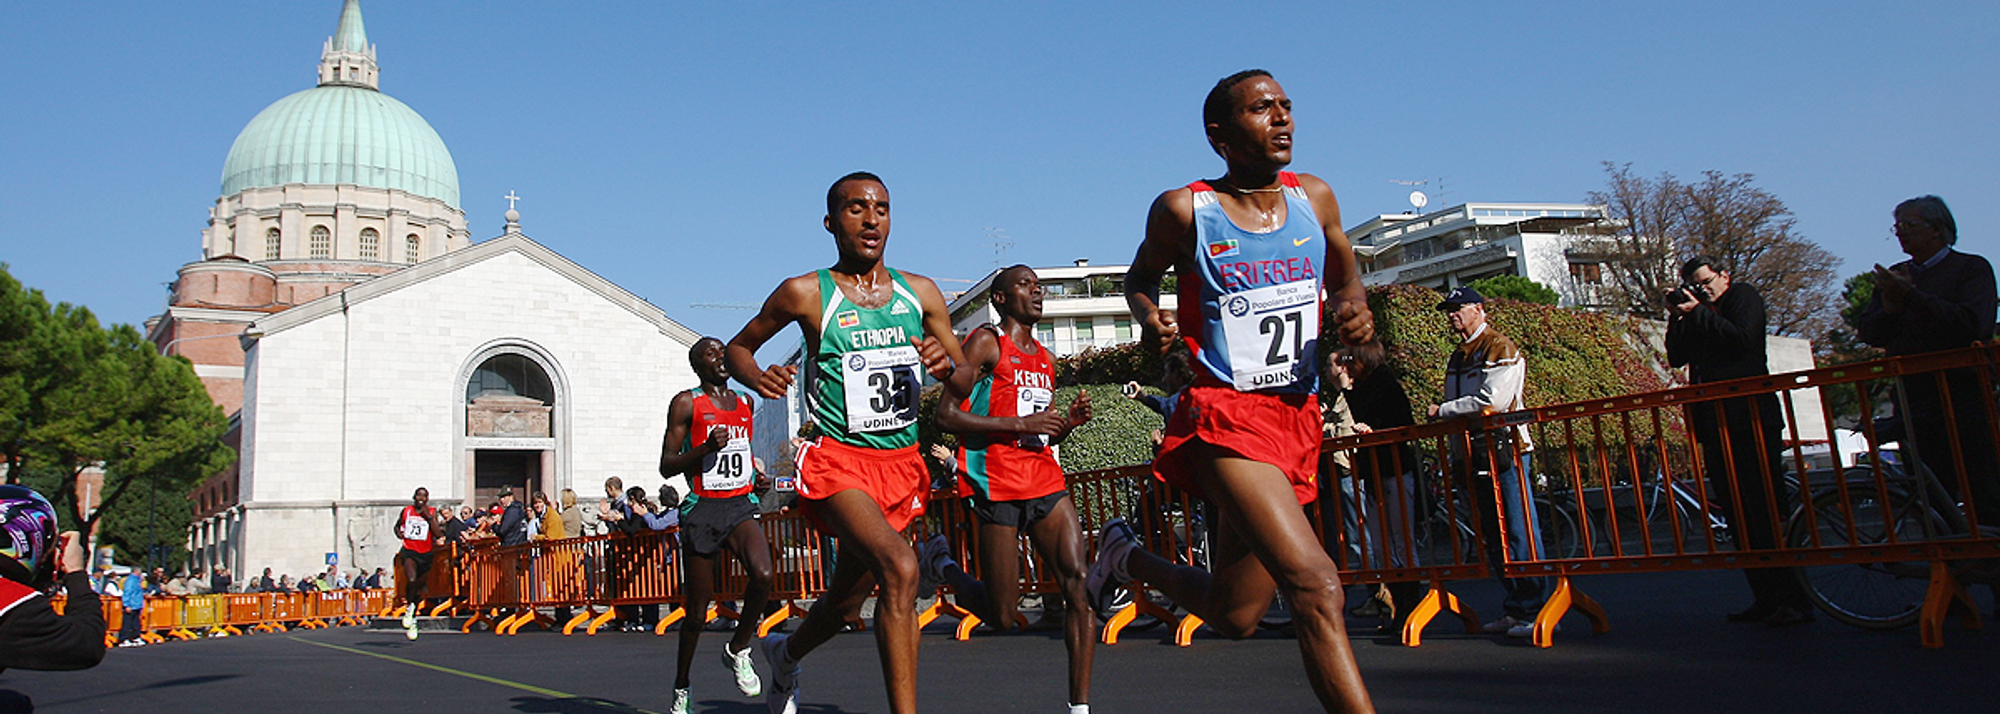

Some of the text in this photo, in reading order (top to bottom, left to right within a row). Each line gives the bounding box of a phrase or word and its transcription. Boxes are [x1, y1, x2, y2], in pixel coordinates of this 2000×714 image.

[1220, 257, 1315, 287] ERITREA
[851, 326, 906, 348] ETHIOPIA
[1260, 311, 1301, 366] 27
[868, 370, 911, 413] 35
[1014, 369, 1052, 390] KENYA
[717, 453, 742, 478] 49
